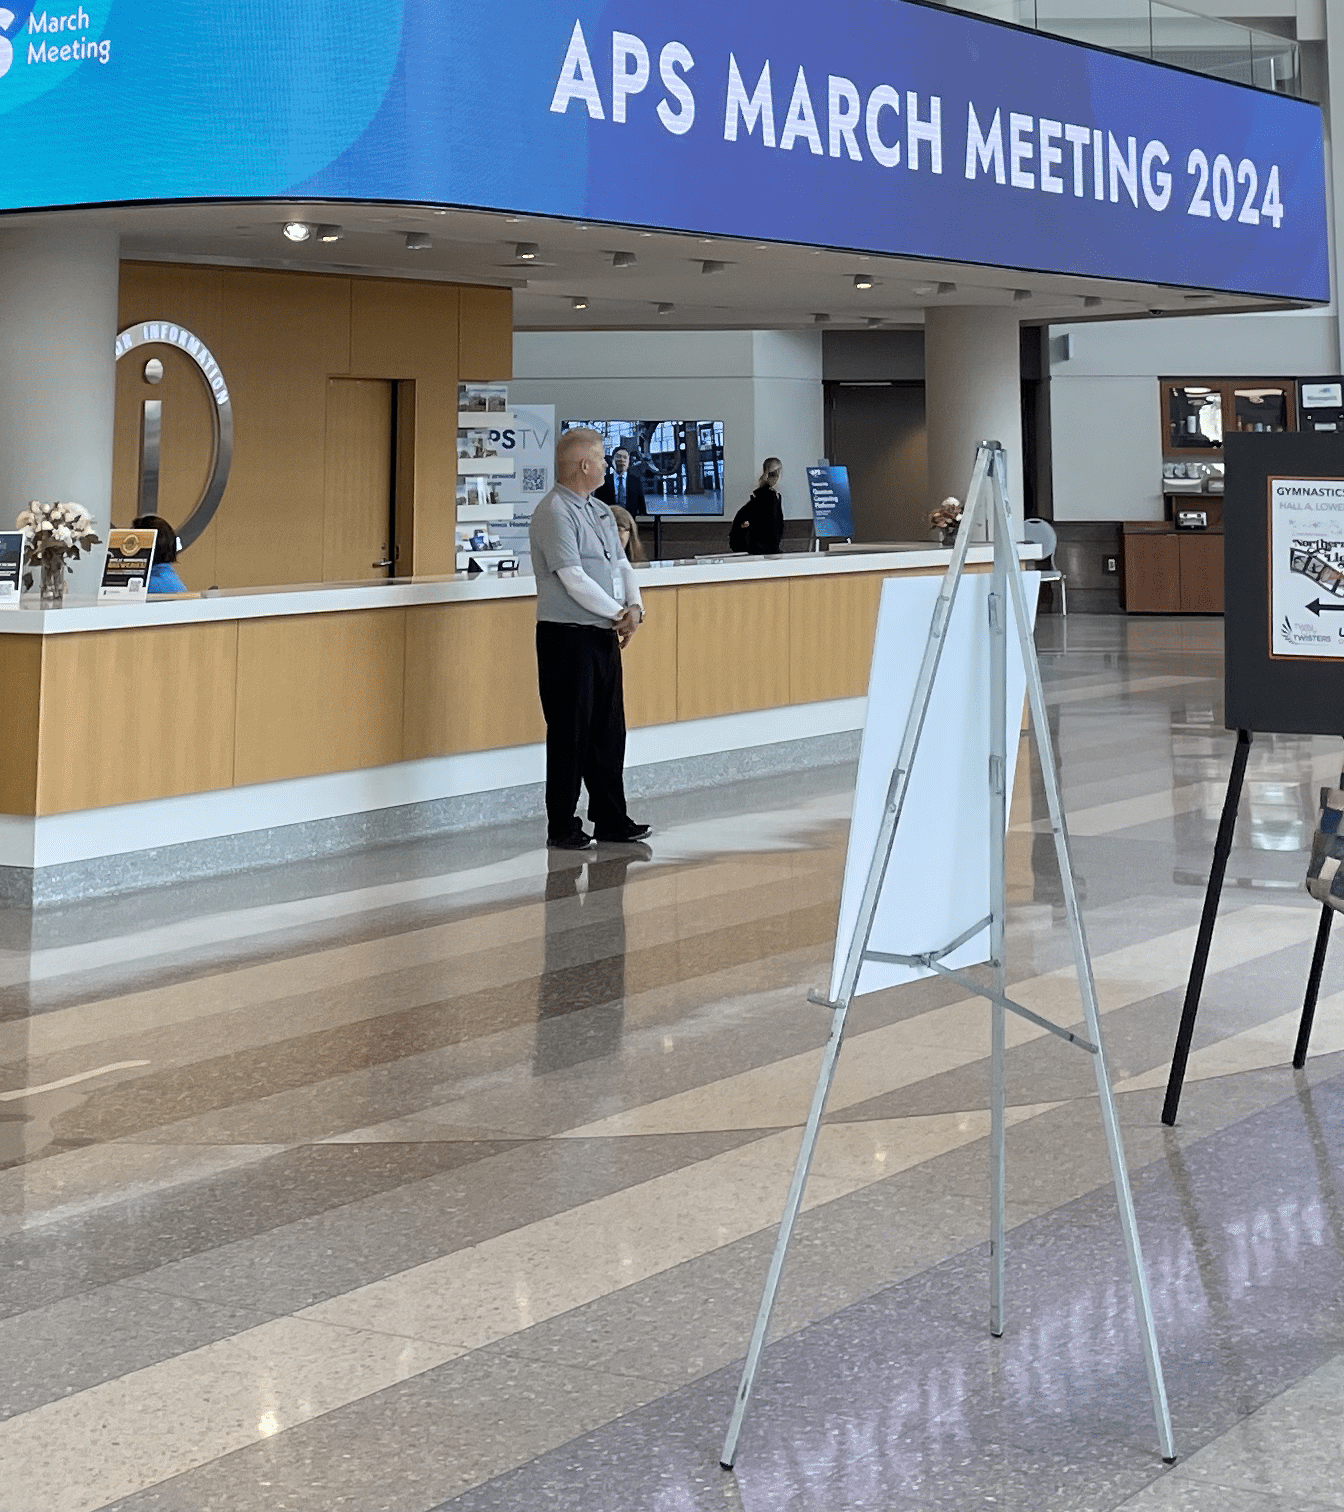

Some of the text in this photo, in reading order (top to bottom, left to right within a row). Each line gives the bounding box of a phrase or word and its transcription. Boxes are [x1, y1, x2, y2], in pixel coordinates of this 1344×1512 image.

[27, 5, 90, 35] March
[27, 36, 112, 65] Meeting
[549, 18, 1285, 229] APS MARCH MEETING 2024
[143, 324, 229, 405] INFORMATION
[1279, 501, 1304, 511] HALL
[1293, 634, 1331, 642] TWISTERS
